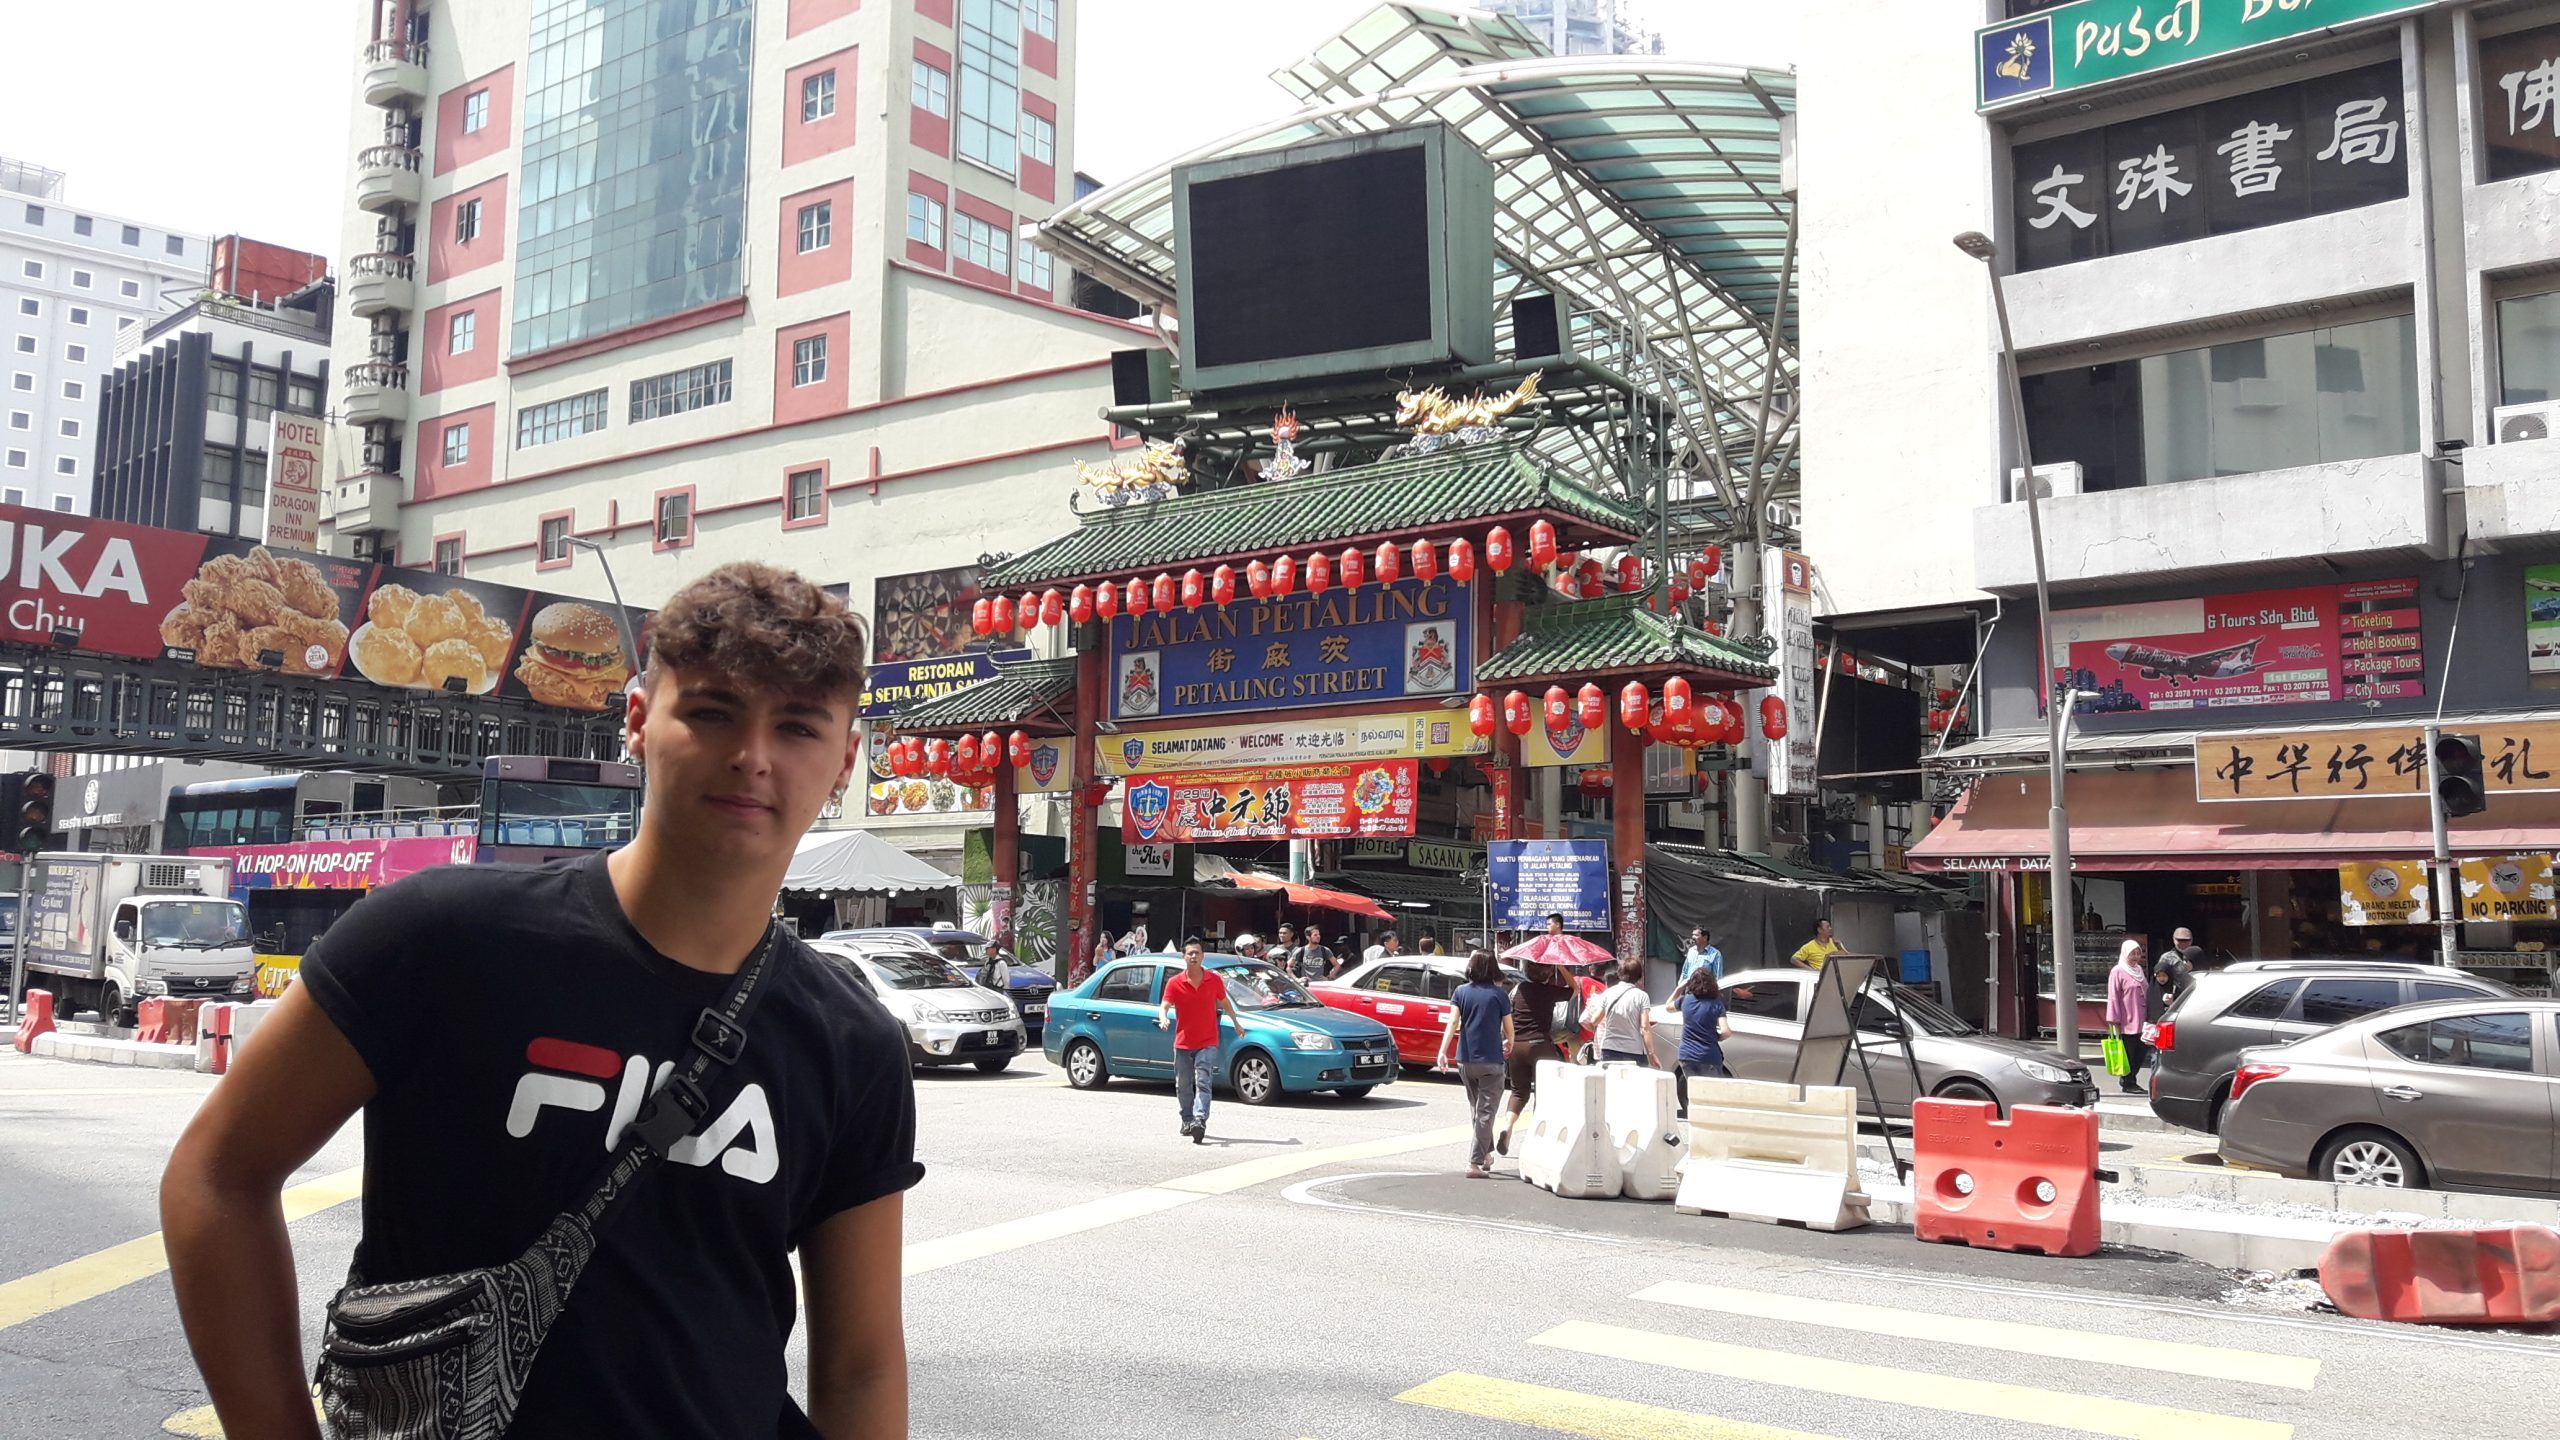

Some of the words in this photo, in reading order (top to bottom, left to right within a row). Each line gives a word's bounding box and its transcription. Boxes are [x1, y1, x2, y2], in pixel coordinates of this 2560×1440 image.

[2029, 96, 2398, 229] 文殊書局
[277, 421, 321, 446] HOTEL
[273, 494, 316, 513] DRAGON
[285, 512, 302, 526] INN
[270, 525, 315, 544] PREMIUM
[1125, 608, 1240, 649] JALAN
[1251, 584, 1449, 636] PETALING
[2208, 616, 2216, 629] &
[2220, 613, 2256, 628] Tours
[2260, 610, 2287, 626] Sdn.
[2291, 606, 2319, 622] Bhd.
[2351, 613, 2393, 628] Ticketing
[2352, 637, 2376, 650] Hotel
[2378, 635, 2416, 649] Booking
[908, 661, 975, 682] RESTORAN
[2354, 658, 2392, 673] Package
[2394, 656, 2421, 669] Tours
[2290, 671, 2321, 681] Floor
[914, 683, 952, 700] CINTA
[1174, 676, 1286, 706] PETALING
[1292, 666, 1388, 697] STREET
[2175, 690, 2191, 698] 2078
[2193, 689, 2208, 697] 7711
[2215, 687, 2224, 695] 03
[2225, 687, 2241, 695] 2078
[2263, 684, 2276, 692] Fax
[2283, 683, 2292, 691] 03
[2293, 682, 2310, 690] 2078
[2312, 680, 2328, 689] 7733
[2355, 683, 2373, 698] City
[2375, 682, 2401, 695] Tours
[1151, 740, 1189, 755] SELAMAT
[1191, 737, 1226, 752] DATANG
[1239, 733, 1284, 749] WELCOME
[1295, 731, 1345, 748] 欢迎光临
[1415, 718, 1424, 752] 丙申年
[2216, 737, 2551, 794] 中华行伴礼
[1190, 826, 1224, 838] Chinese
[1140, 845, 1161, 864] Ais
[1356, 838, 1396, 854] HOTEL
[254, 853, 308, 873] HOP-ON
[308, 851, 375, 873] HOP-OFF
[1418, 845, 1464, 869] SASANA
[1943, 857, 2009, 871] SELAMAT
[2019, 857, 2077, 871] DATAG
[2361, 900, 2387, 911] ARANG
[2388, 900, 2421, 910] MELETAK
[2471, 902, 2489, 916] NO
[2494, 899, 2547, 916] PARKING
[507, 1037, 779, 1184] FILA
